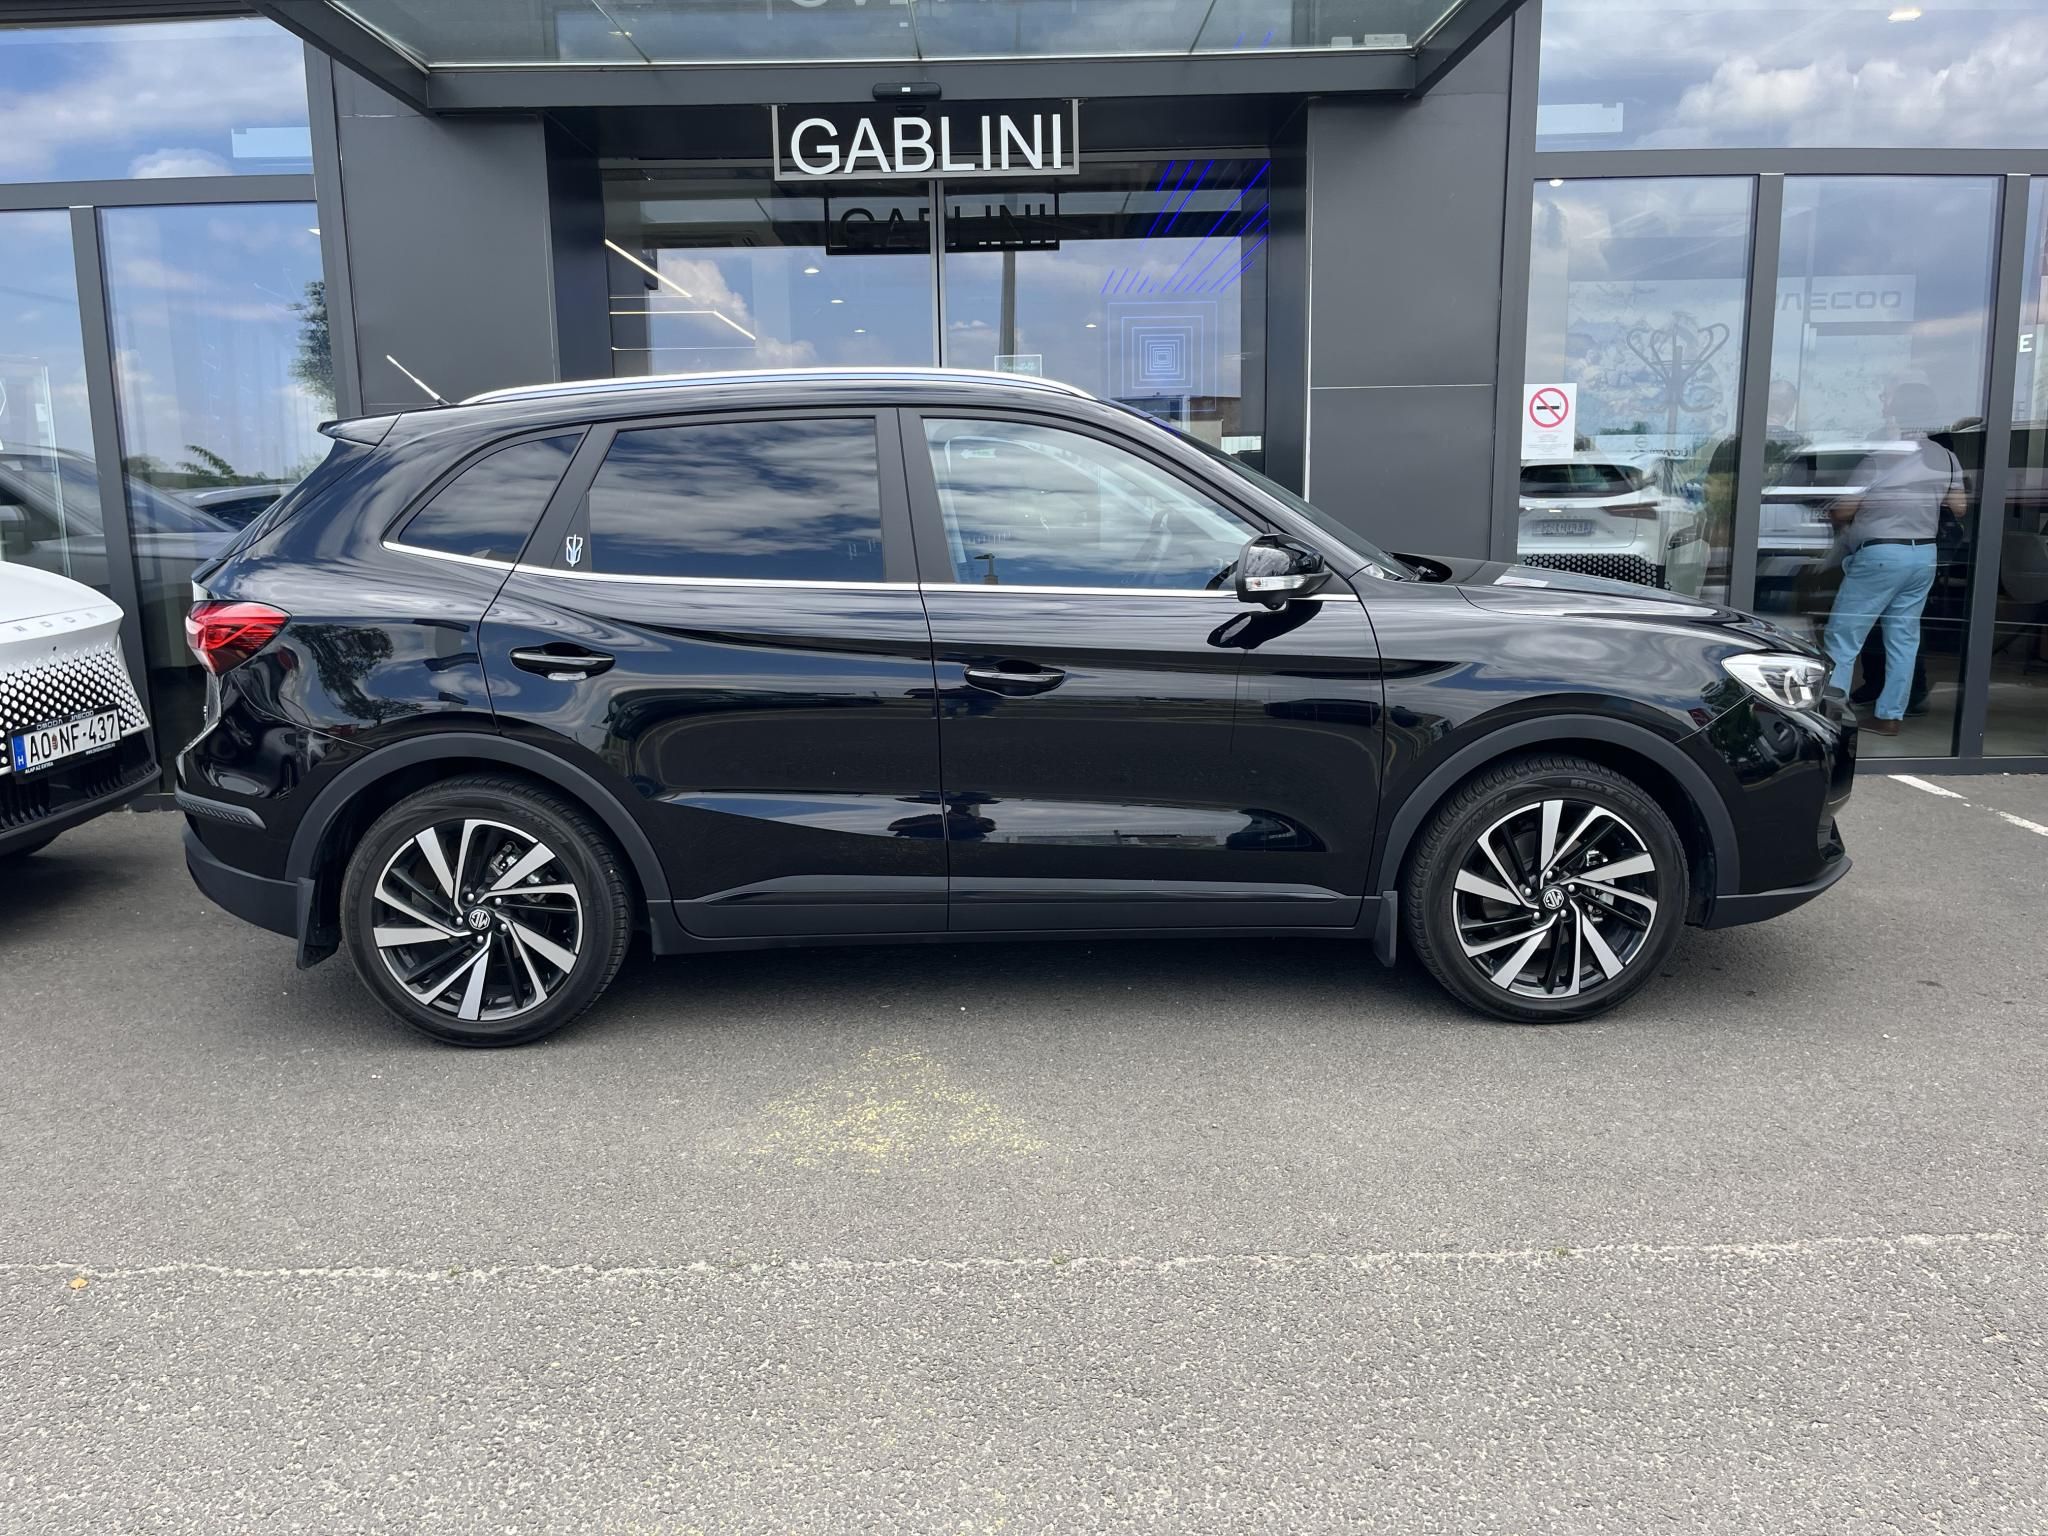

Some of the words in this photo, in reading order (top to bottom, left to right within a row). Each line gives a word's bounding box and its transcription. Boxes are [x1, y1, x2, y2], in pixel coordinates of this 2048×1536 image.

[791, 114, 1061, 175] GABLINI
[1776, 290, 1902, 311] AECOO
[17, 755, 25, 766] H
[1544, 890, 1563, 908] MG
[470, 910, 489, 929] MG
